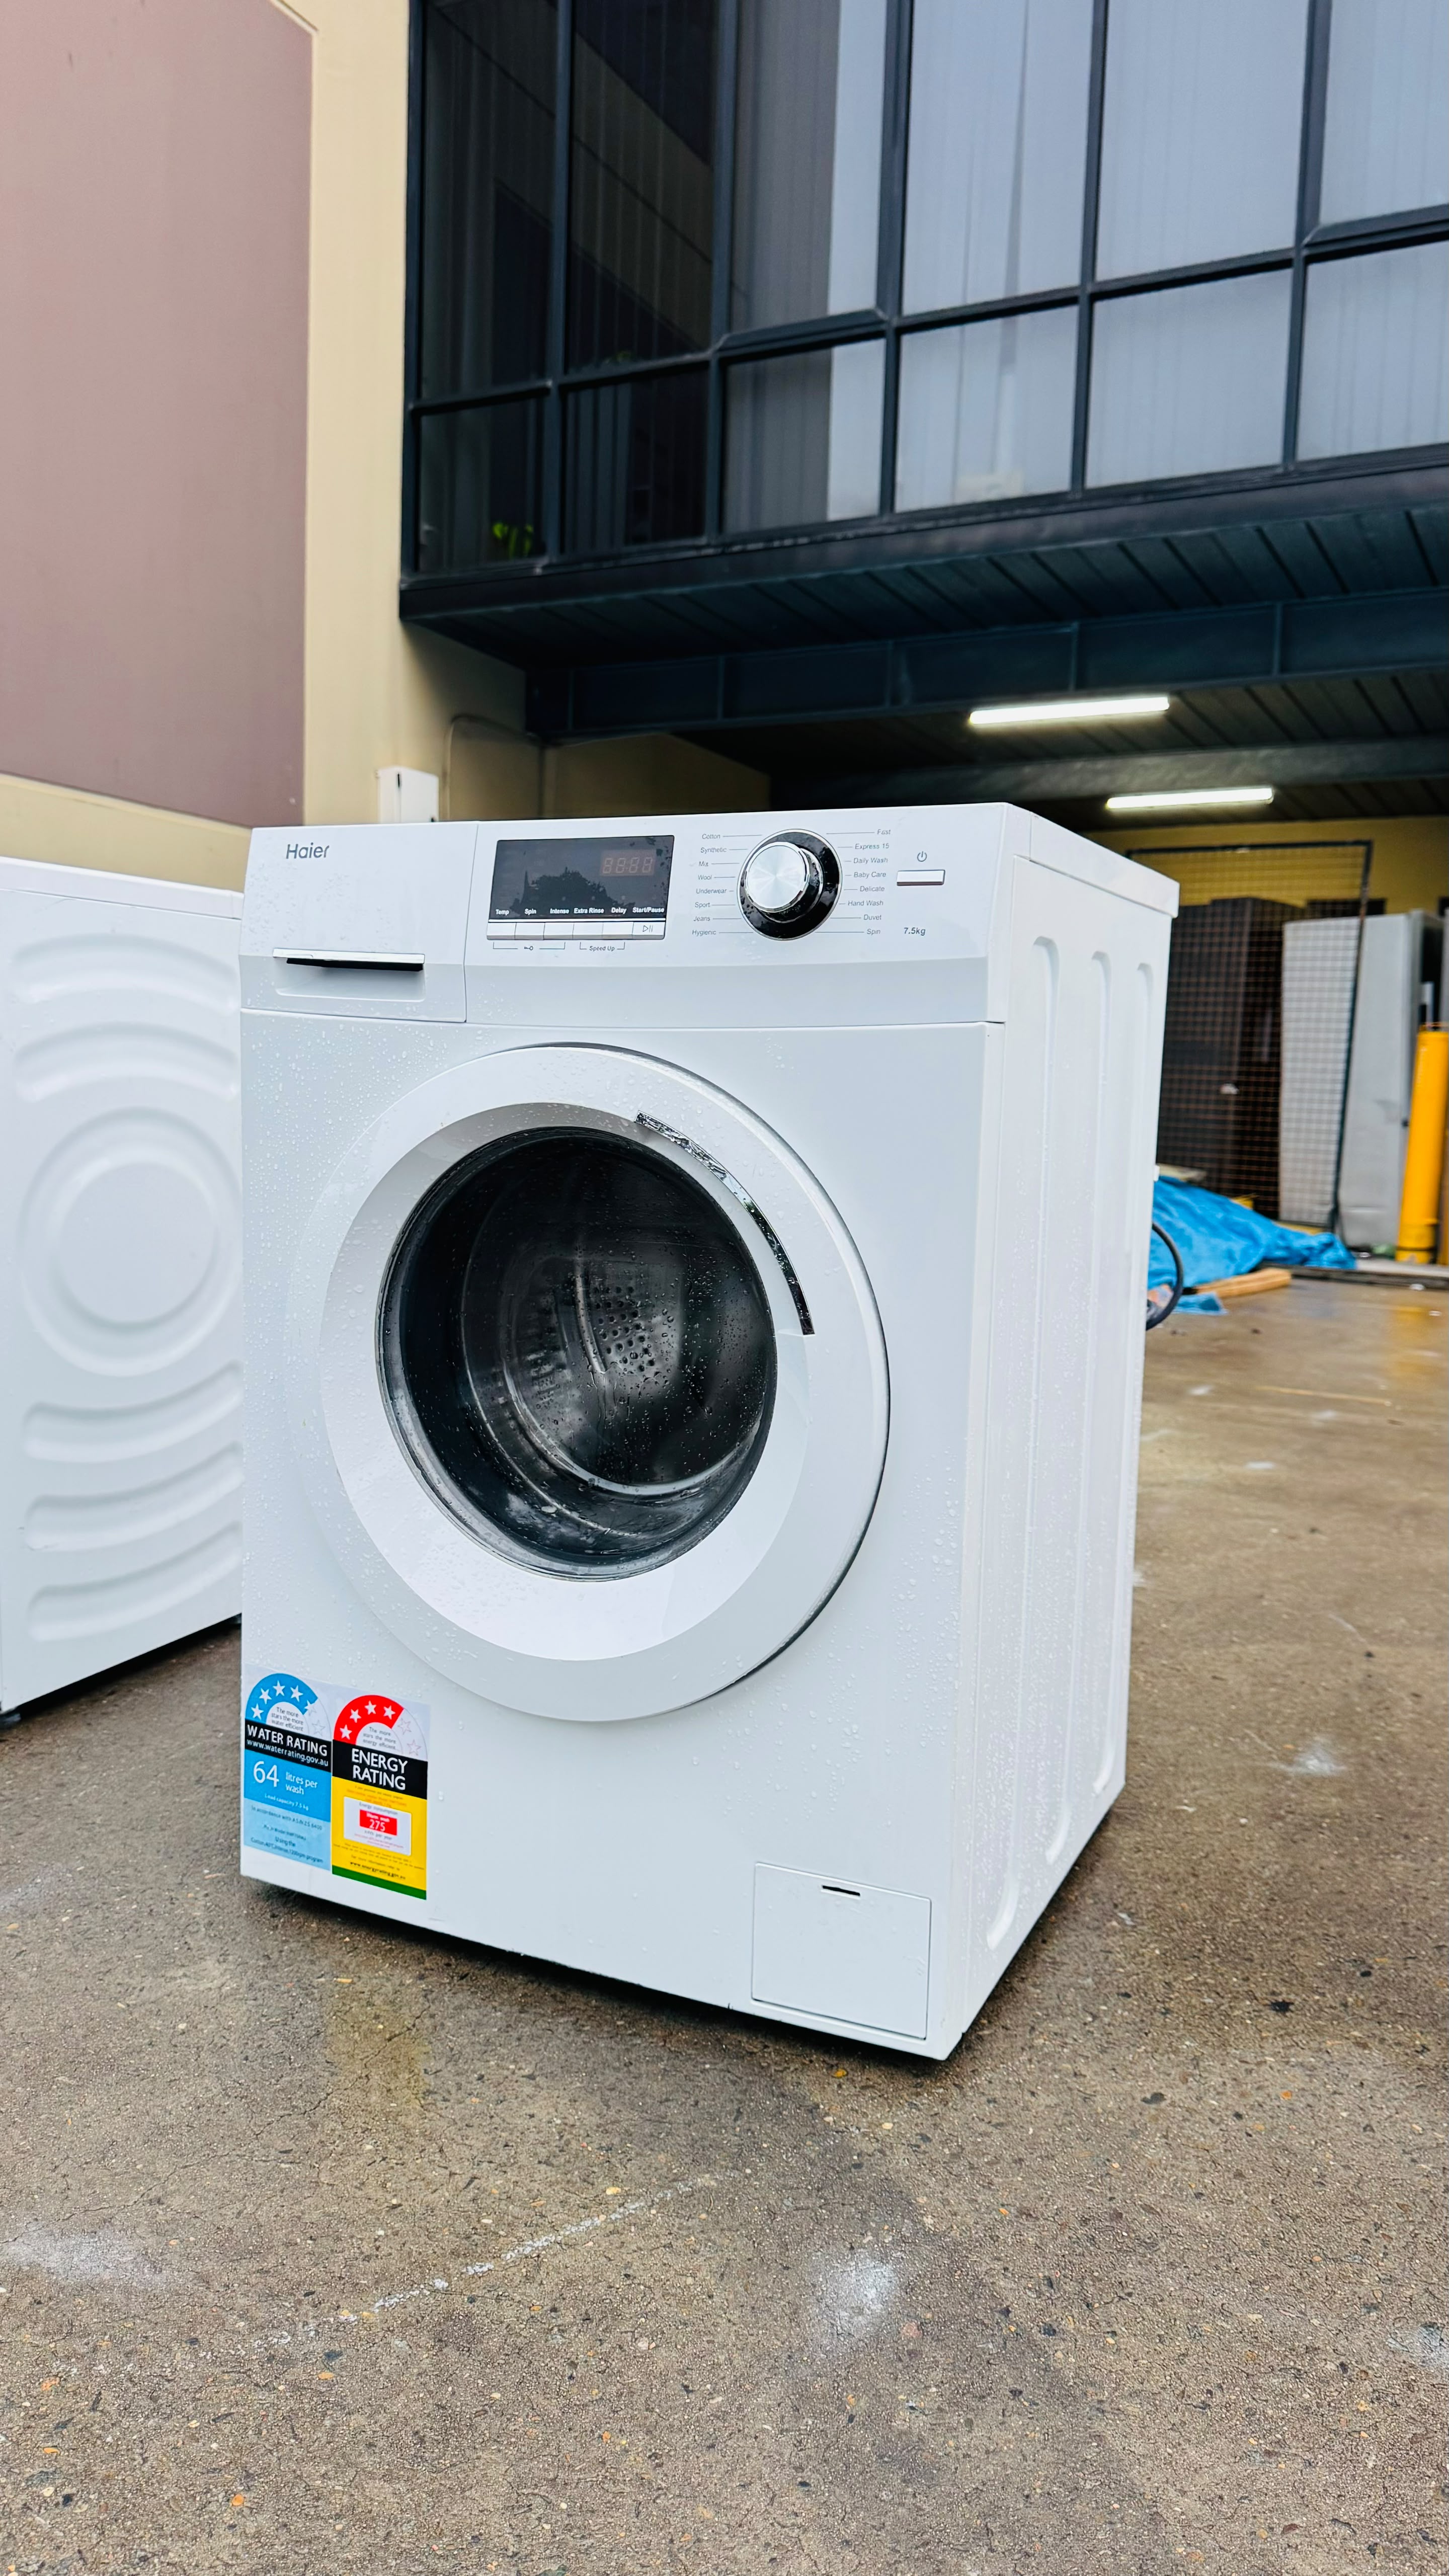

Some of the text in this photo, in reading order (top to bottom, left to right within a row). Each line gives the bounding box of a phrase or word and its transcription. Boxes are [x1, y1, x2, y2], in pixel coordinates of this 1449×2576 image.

[286, 842, 330, 859] Haier
[904, 927, 926, 936] 7.5kg
[286, 1710, 299, 1718] more
[285, 1723, 304, 1731] efficient
[247, 1724, 328, 1756] WATER RATING
[247, 1739, 329, 1766] www.waterrating.gov.au
[352, 1748, 408, 1774] ENERGY
[253, 1760, 279, 1787] 64
[285, 1772, 317, 1788] litres per
[353, 1764, 406, 1791] RATING
[265, 1793, 276, 1801] Load
[285, 1784, 304, 1795] wash
[369, 1819, 385, 1832] 275
